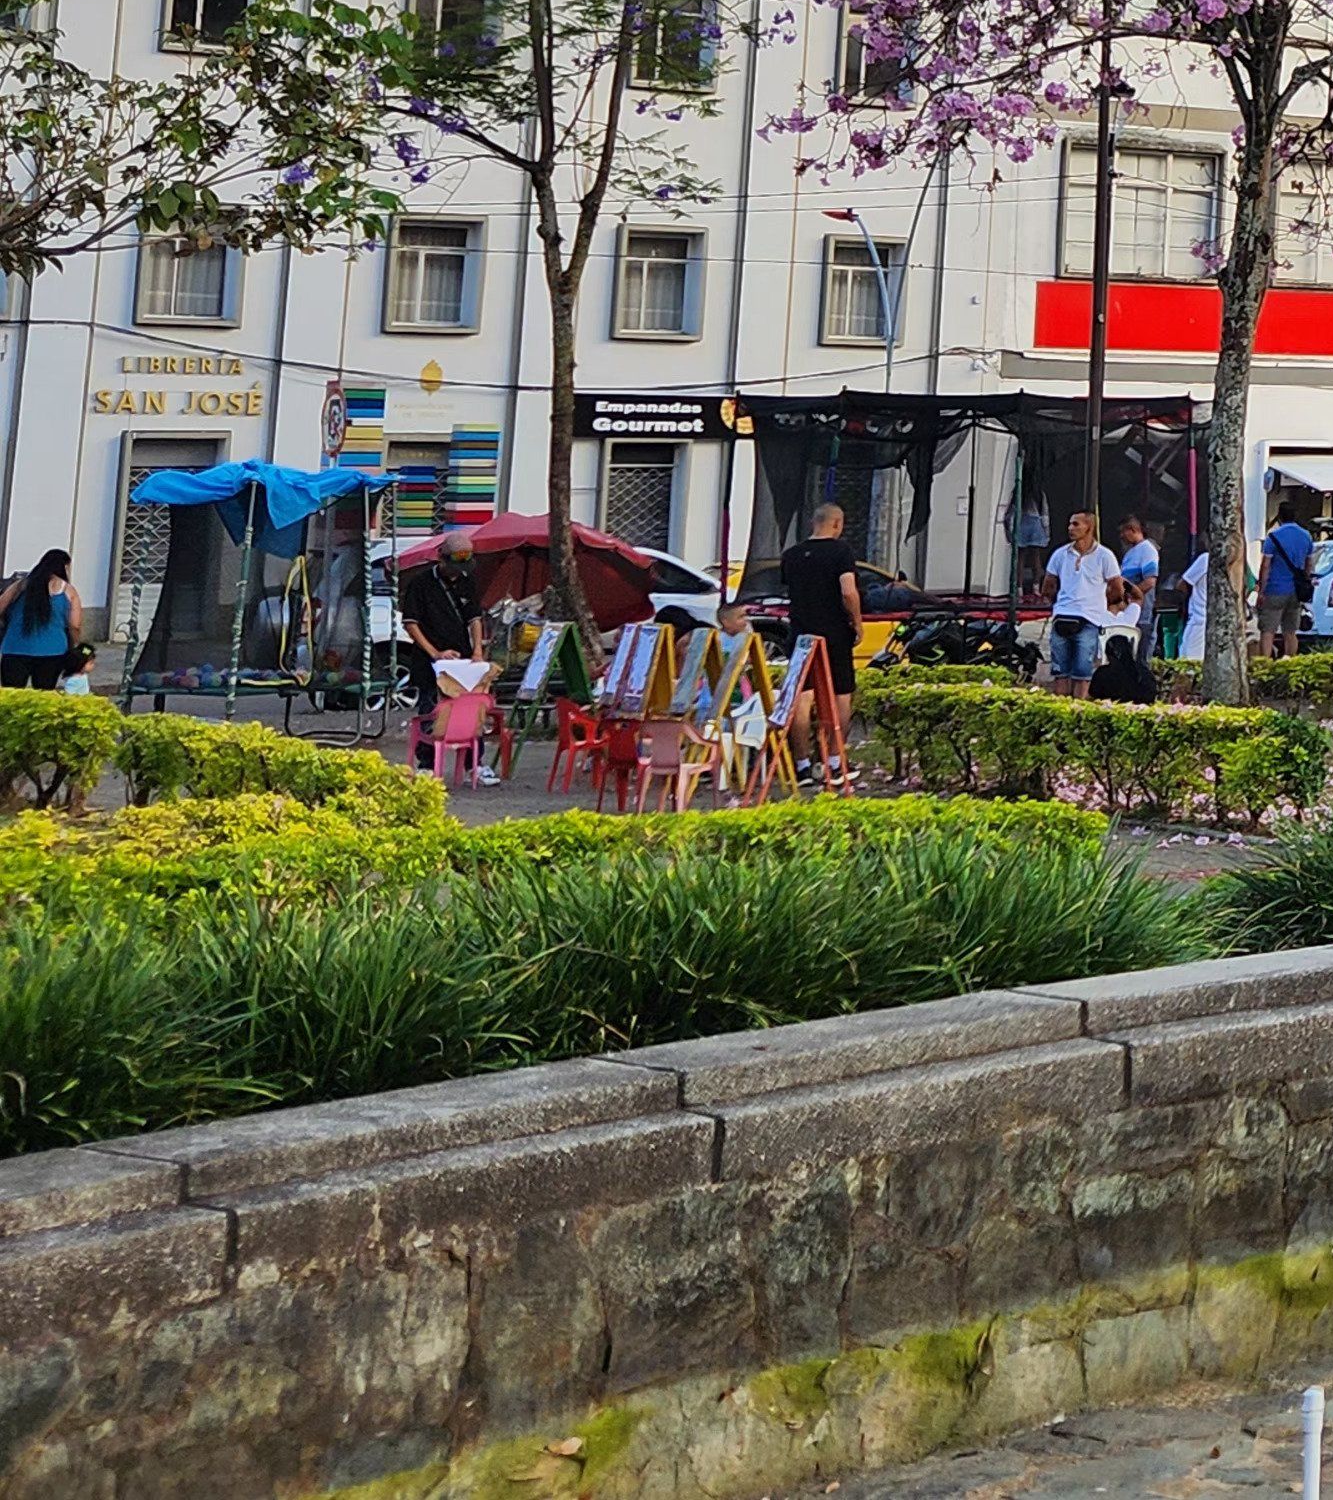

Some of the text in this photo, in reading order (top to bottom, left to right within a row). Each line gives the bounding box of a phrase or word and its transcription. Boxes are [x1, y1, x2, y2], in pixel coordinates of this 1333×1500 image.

[95, 380, 263, 416] SAN JOSÉ
[595, 401, 702, 414] Empanadas
[592, 417, 704, 432] Gourmet
